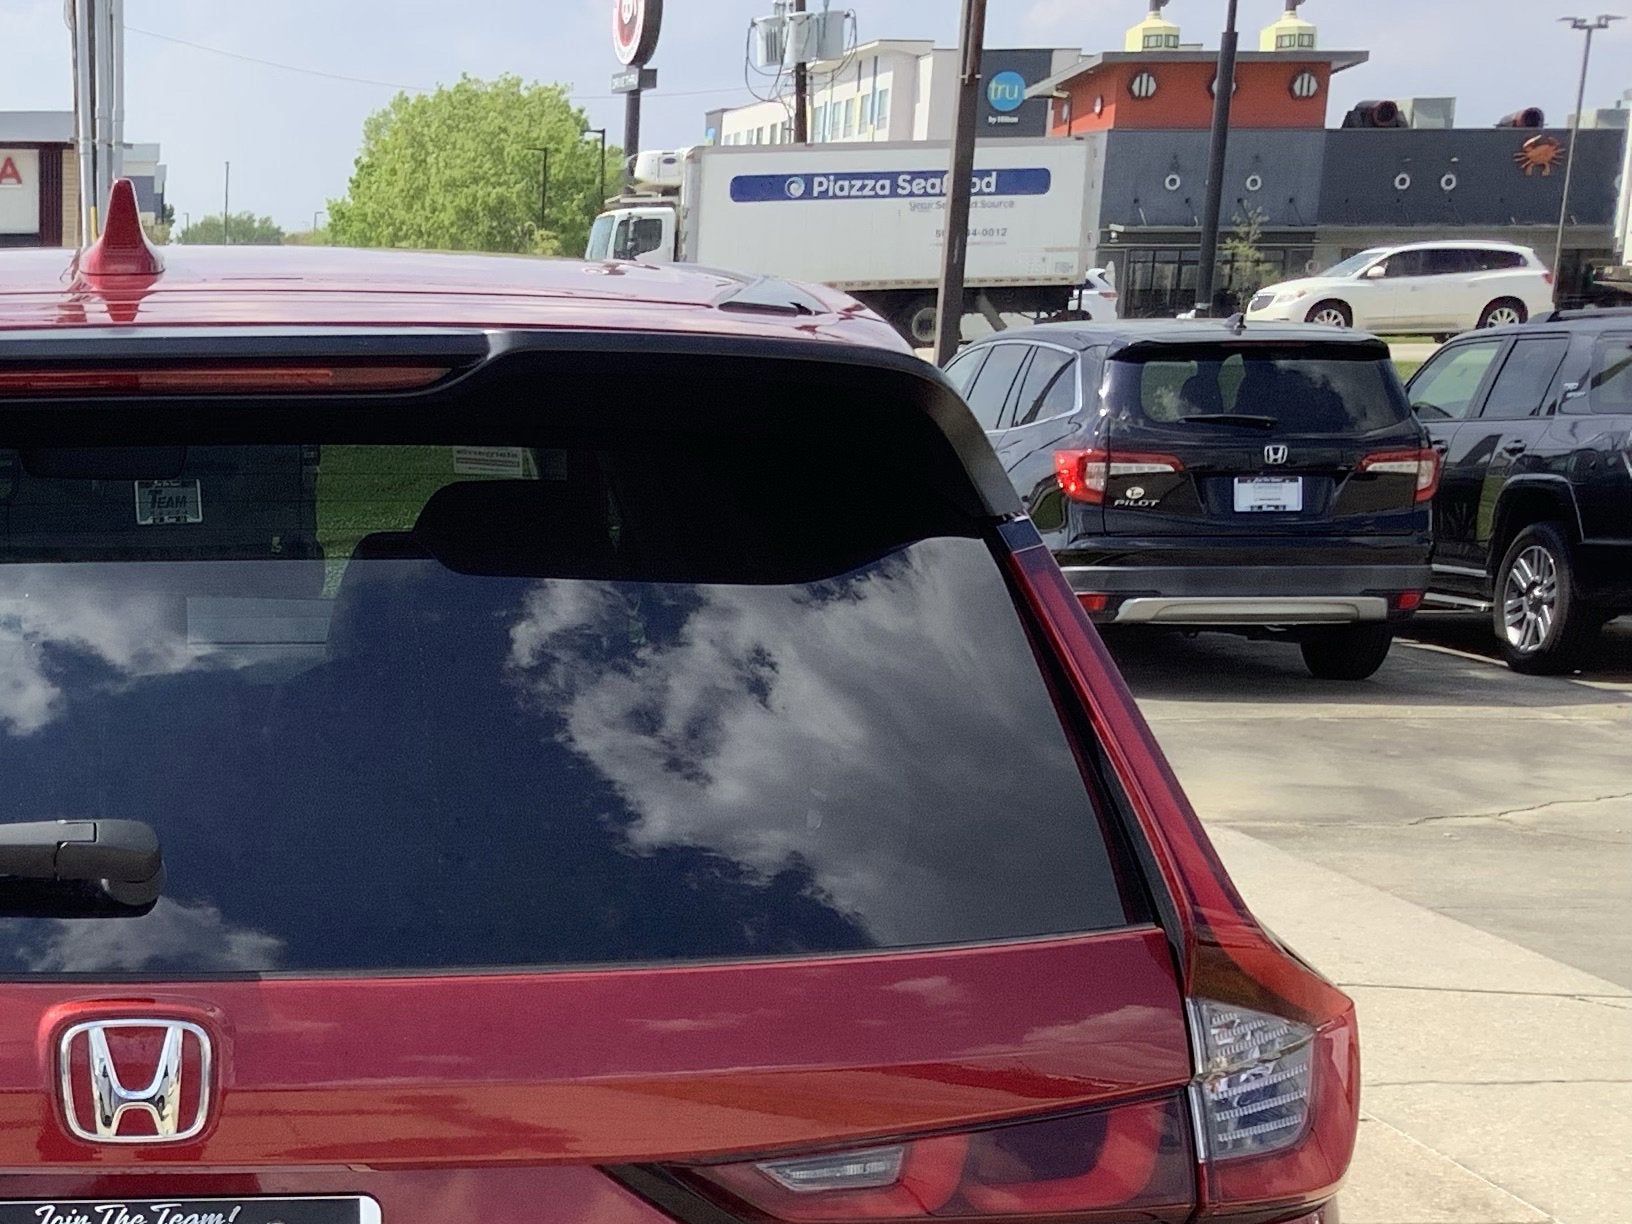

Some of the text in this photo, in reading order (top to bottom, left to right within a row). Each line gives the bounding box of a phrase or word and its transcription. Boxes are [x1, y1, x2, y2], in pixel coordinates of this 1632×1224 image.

[813, 171, 997, 197] Piazza Seafod
[1113, 499, 1161, 507] PILOT
